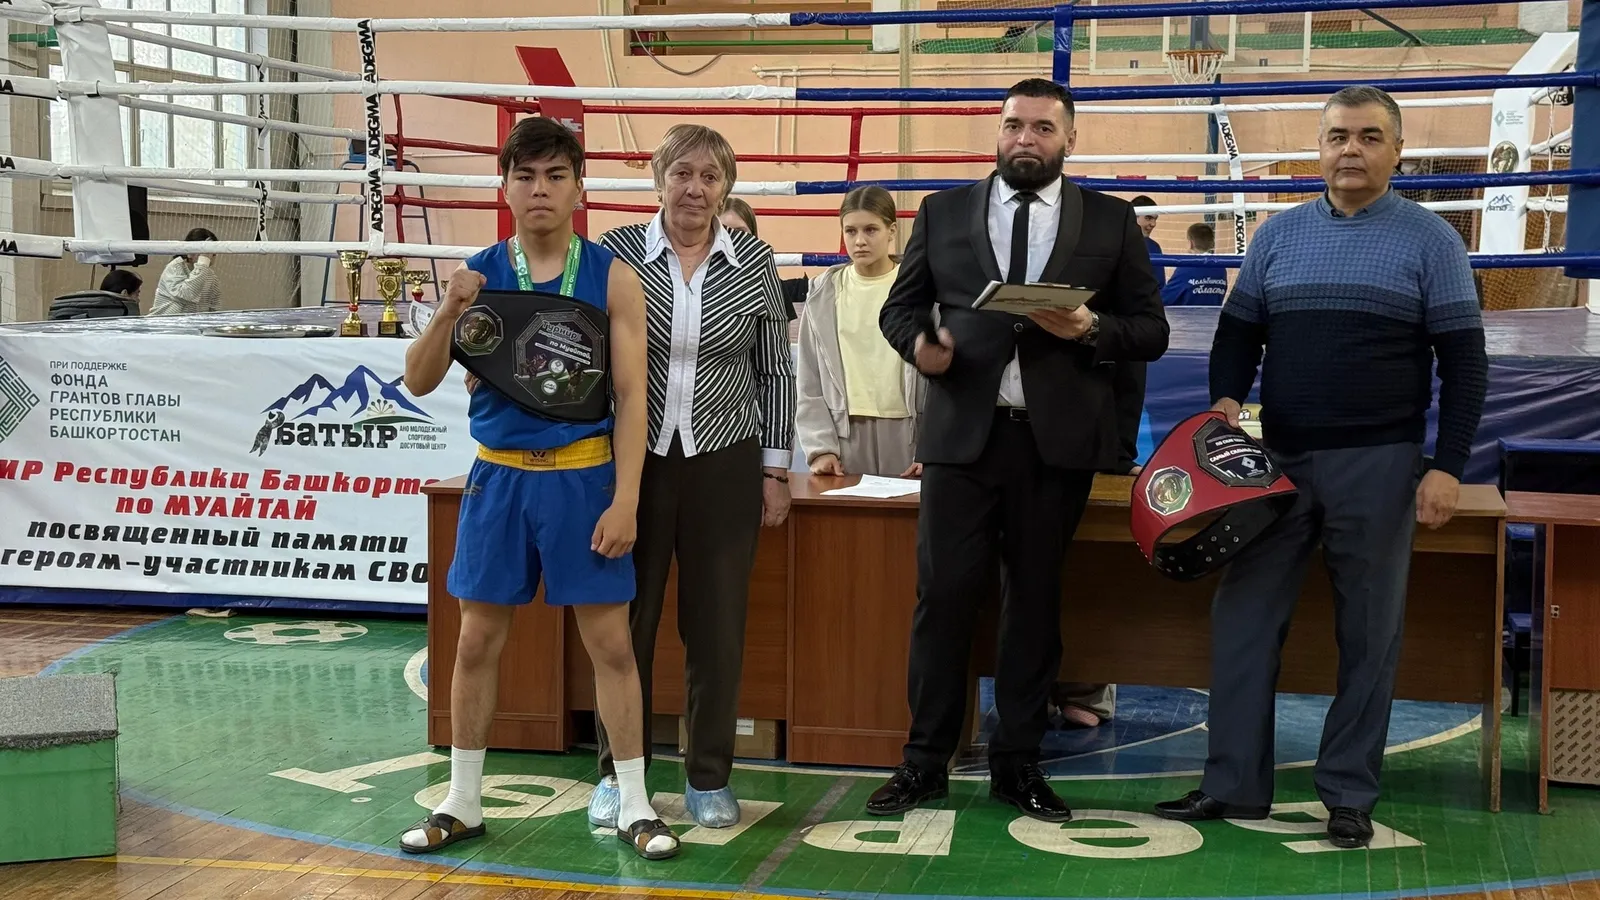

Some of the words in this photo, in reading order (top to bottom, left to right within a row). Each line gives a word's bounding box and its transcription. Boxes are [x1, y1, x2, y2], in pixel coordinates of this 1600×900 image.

[358, 19, 376, 83] ADEGMA
[366, 93, 380, 159] ADEGMA
[1220, 122, 1239, 160] ADEGMA
[368, 168, 384, 232] ADEGMA
[1235, 214, 1246, 255] ADEGMA
[50, 361, 68, 370] ПРИ
[71, 361, 128, 372] ПОДДЕРЖКЕ
[50, 373, 109, 389] ФОНДА
[50, 391, 121, 405] ГРАНТОВ
[126, 393, 181, 407] ГЛАВЫ
[50, 408, 157, 424] РЕСПУБЛИКИ
[50, 425, 181, 442] БАШКОРТОСТАН
[53, 461, 249, 490] Республики
[116, 497, 153, 514] по
[164, 493, 317, 520] МУАЙТАЙ
[27, 521, 260, 548] посвященный
[271, 532, 408, 553] памяти
[369, 561, 428, 584] СВО
